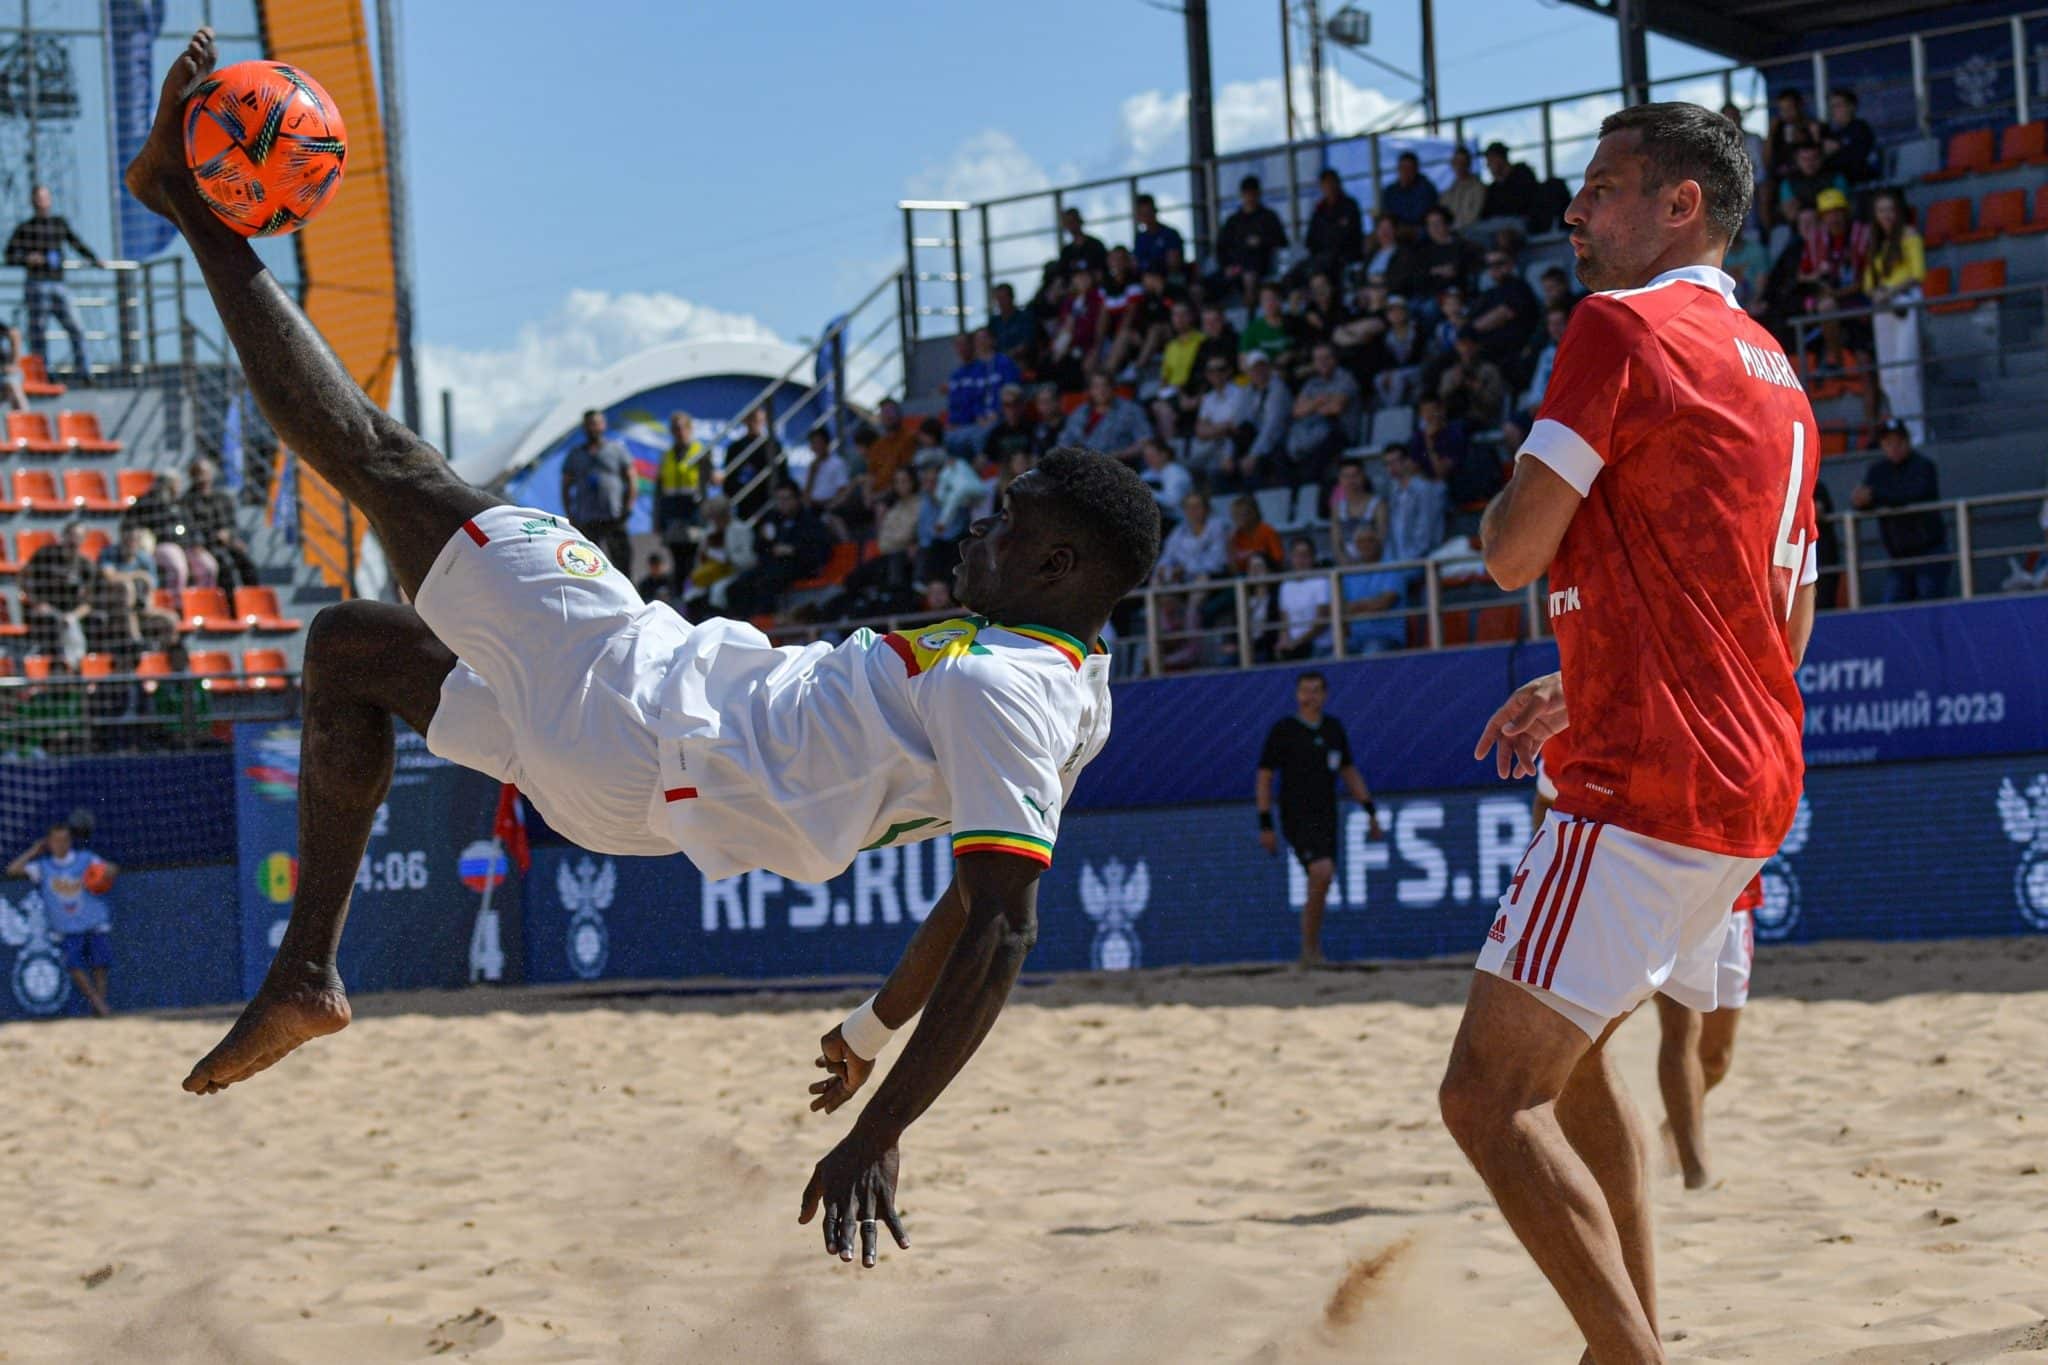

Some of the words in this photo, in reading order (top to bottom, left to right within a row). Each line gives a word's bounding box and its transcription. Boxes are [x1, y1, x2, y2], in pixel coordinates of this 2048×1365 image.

[1773, 421, 1807, 622] 4
[1799, 657, 1884, 694] СИТИ
[1832, 690, 1931, 735] НАЦИЙ
[1936, 692, 2006, 727] 2023
